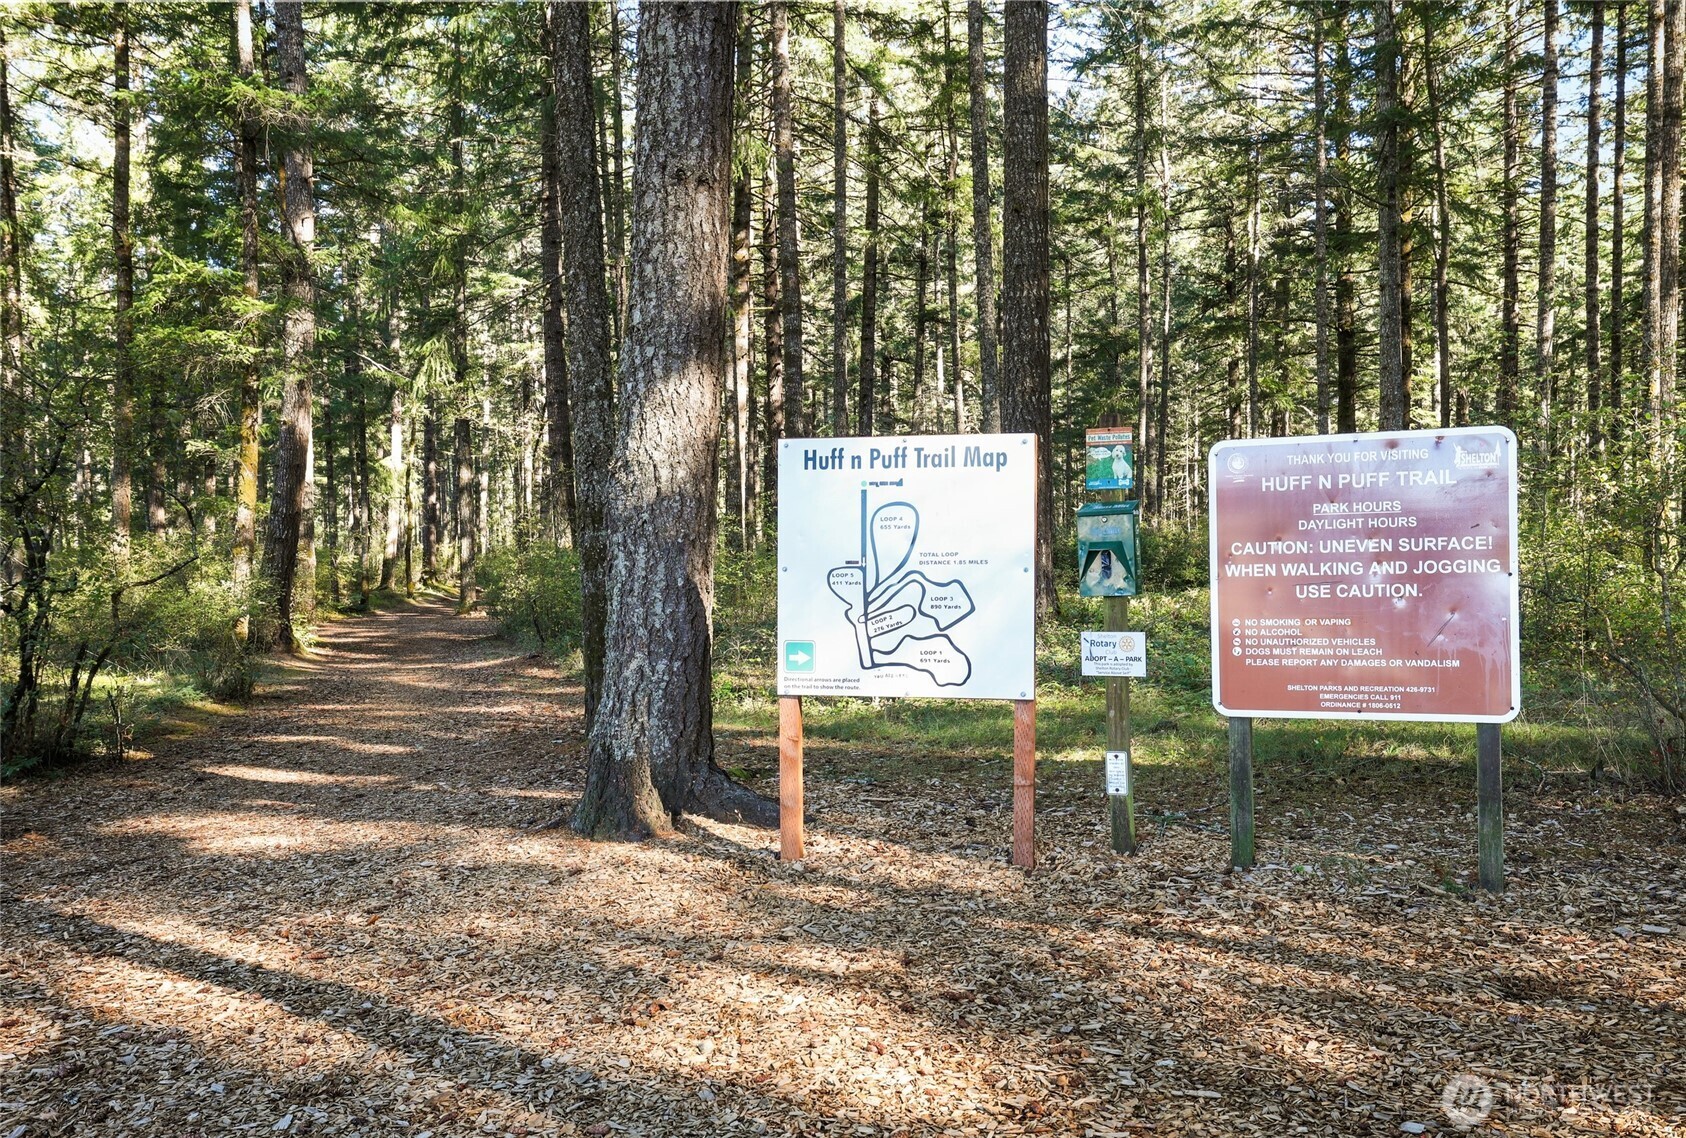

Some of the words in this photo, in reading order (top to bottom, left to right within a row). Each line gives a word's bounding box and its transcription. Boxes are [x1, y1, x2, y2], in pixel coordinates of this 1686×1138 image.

[804, 448, 844, 470] Huff
[851, 455, 862, 469] n
[870, 446, 908, 468] Puff
[914, 446, 956, 468] Trail
[964, 446, 1008, 472] Map
[1287, 454, 1325, 466] THANK
[1326, 453, 1350, 464] YOU
[1354, 452, 1377, 462] FOR
[1380, 448, 1429, 461] VISITING
[1460, 452, 1496, 464] SHELTON
[1262, 476, 1312, 492] HUFF
[1318, 475, 1332, 489] N
[1338, 472, 1390, 488] PUFF
[1396, 470, 1457, 486] TRAIL
[1313, 503, 1348, 514] PARK
[1353, 500, 1402, 512] HOURS
[1298, 518, 1364, 530] DAYLIGHT
[1368, 517, 1417, 528] HOURS
[1231, 542, 1313, 555] CAUTION:
[1320, 539, 1392, 553] UNEVEN
[1399, 536, 1493, 551] SURFACE!
[1226, 564, 1276, 577] WHEN
[1281, 562, 1364, 576] WALKING
[1368, 561, 1408, 574] AND
[1413, 559, 1500, 574] JOGGING
[1296, 585, 1330, 598] USE
[1336, 584, 1422, 598] CAUTION.
[871, 617, 887, 626] LOOP
[885, 620, 903, 630] Yards
[1090, 640, 1117, 648] Rotary
[1246, 658, 1280, 666] PLEASE
[1282, 658, 1317, 667] REPORT
[1341, 659, 1387, 667] DAMAGES
[1404, 660, 1460, 668] VANDALISM
